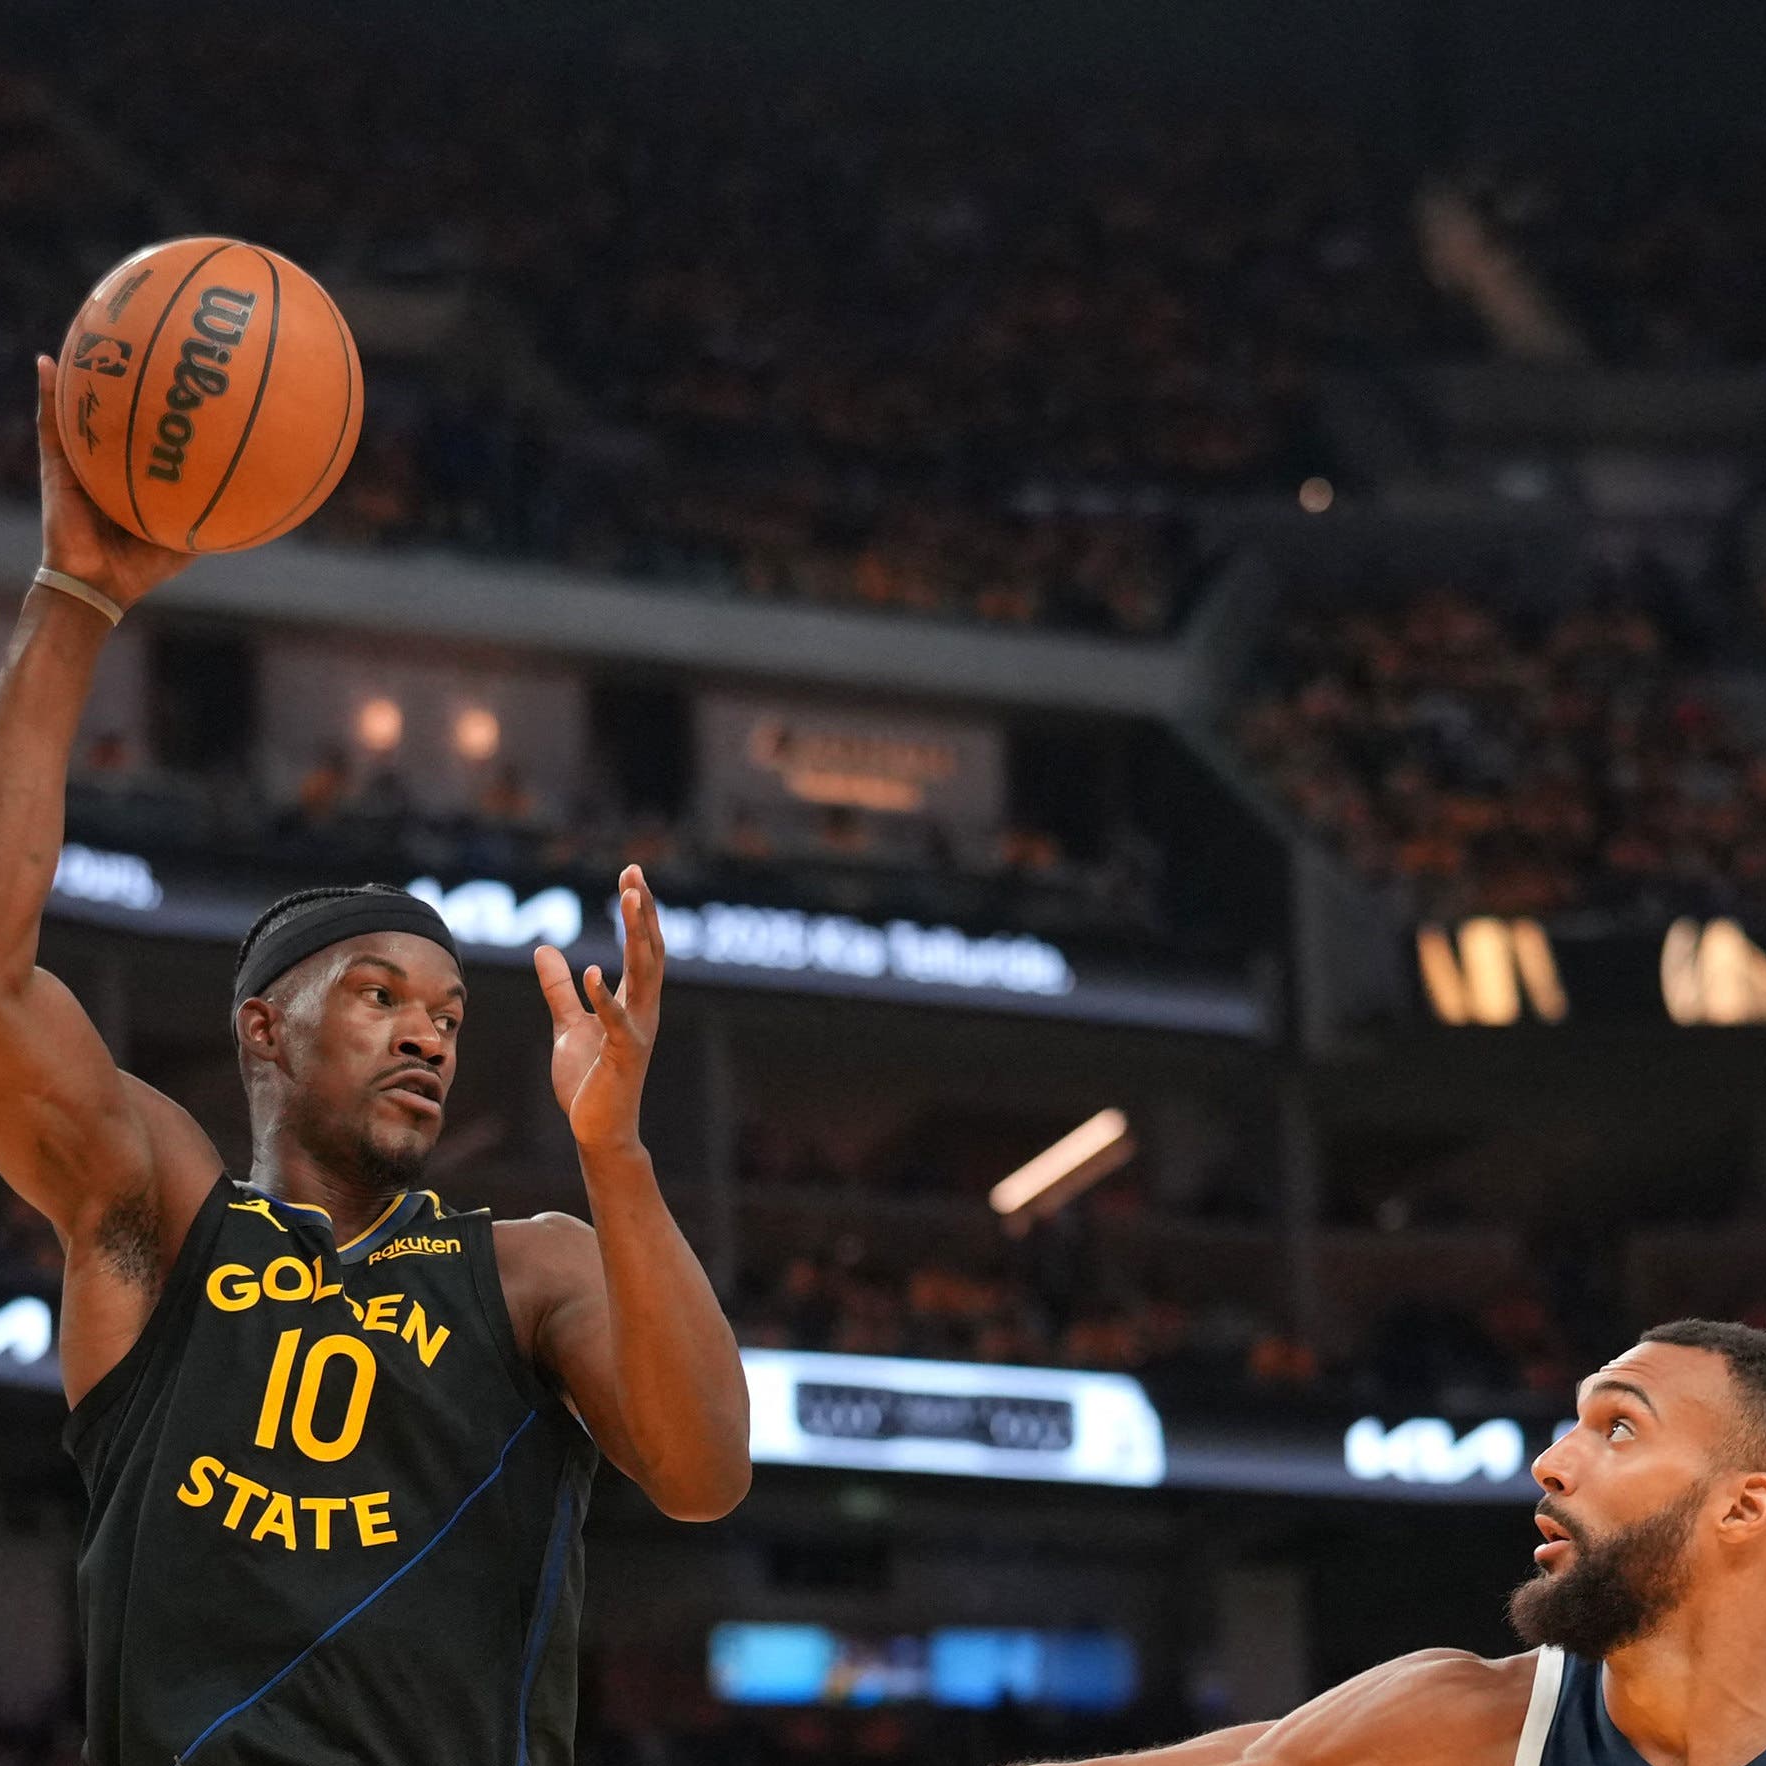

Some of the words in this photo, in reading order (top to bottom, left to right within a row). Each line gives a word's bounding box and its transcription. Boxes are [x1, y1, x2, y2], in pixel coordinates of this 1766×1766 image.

[145, 286, 257, 484] Wilson
[368, 1236, 461, 1266] Rakuten
[254, 1327, 376, 1462] 10
[177, 1456, 398, 1551] STATE
